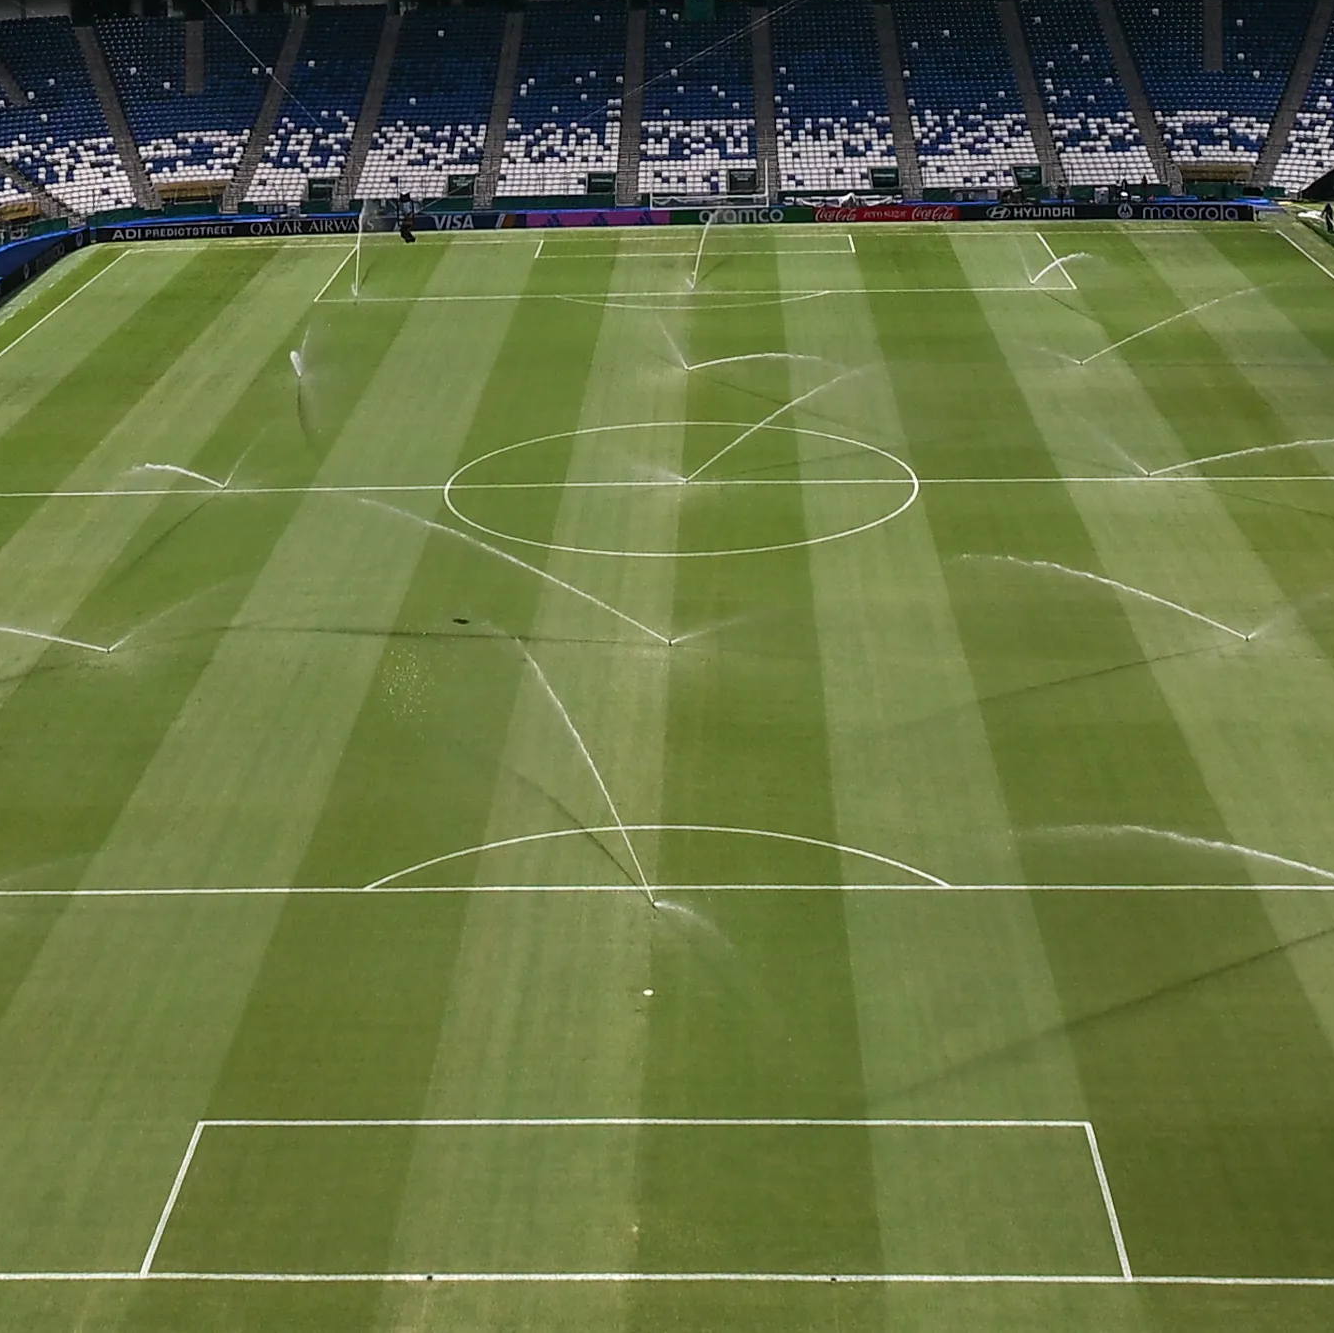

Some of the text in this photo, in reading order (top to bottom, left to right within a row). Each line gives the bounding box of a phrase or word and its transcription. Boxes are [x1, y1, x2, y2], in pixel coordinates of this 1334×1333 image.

[698, 207, 784, 224] aramco
[1014, 206, 1076, 218] HYUNDAI
[1142, 204, 1240, 221] motorola
[249, 218, 375, 236] QATAR AIRWAS
[431, 212, 475, 230] VISA
[111, 225, 235, 241] ADI PREDICTSTREET
